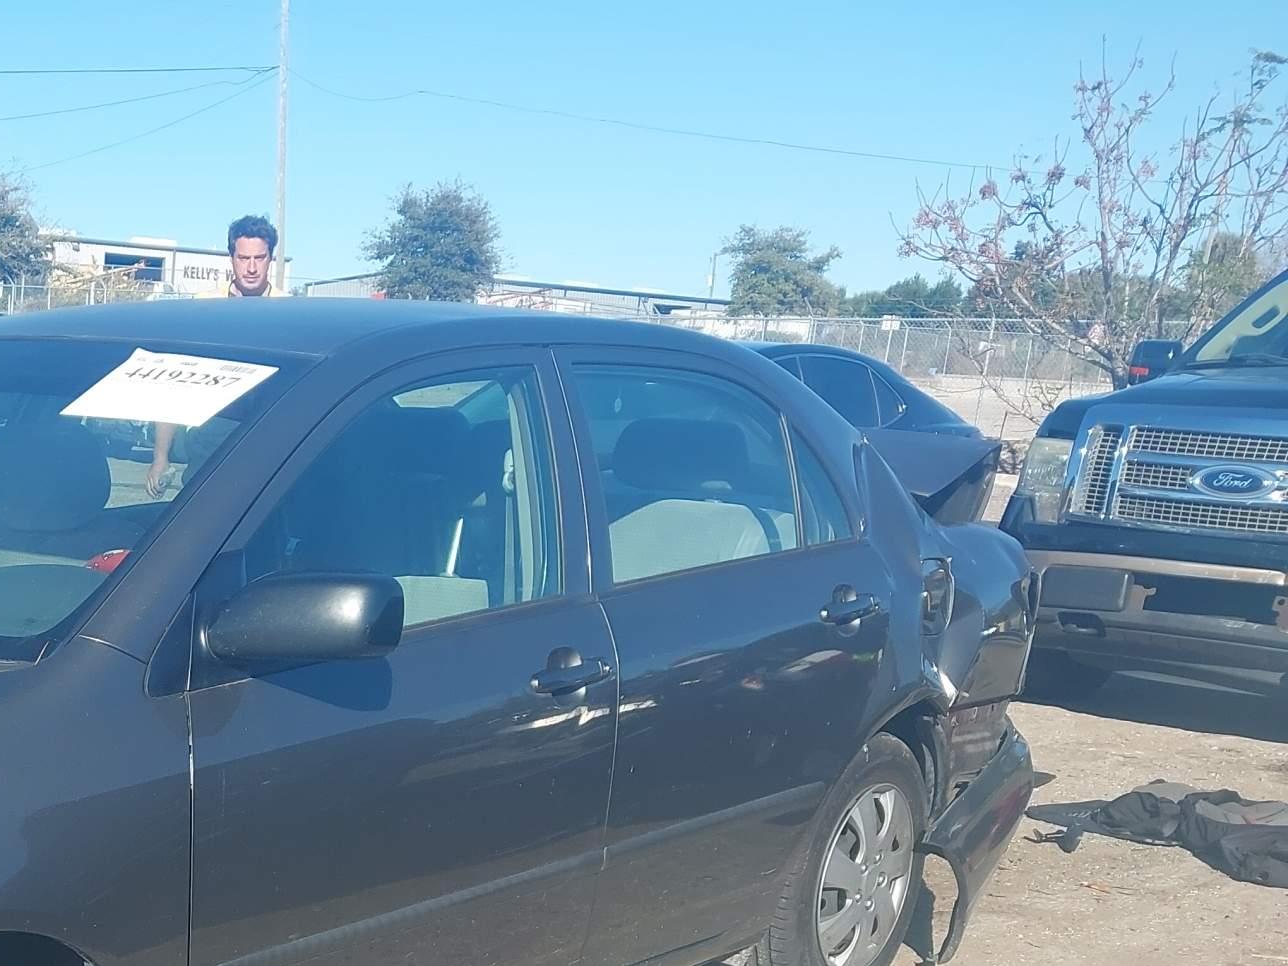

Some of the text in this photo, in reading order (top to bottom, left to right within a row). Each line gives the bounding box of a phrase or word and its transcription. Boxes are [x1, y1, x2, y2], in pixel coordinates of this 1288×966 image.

[183, 265, 220, 281] KELLY'S
[125, 367, 241, 387] 44192287
[1212, 472, 1253, 489] Ford
